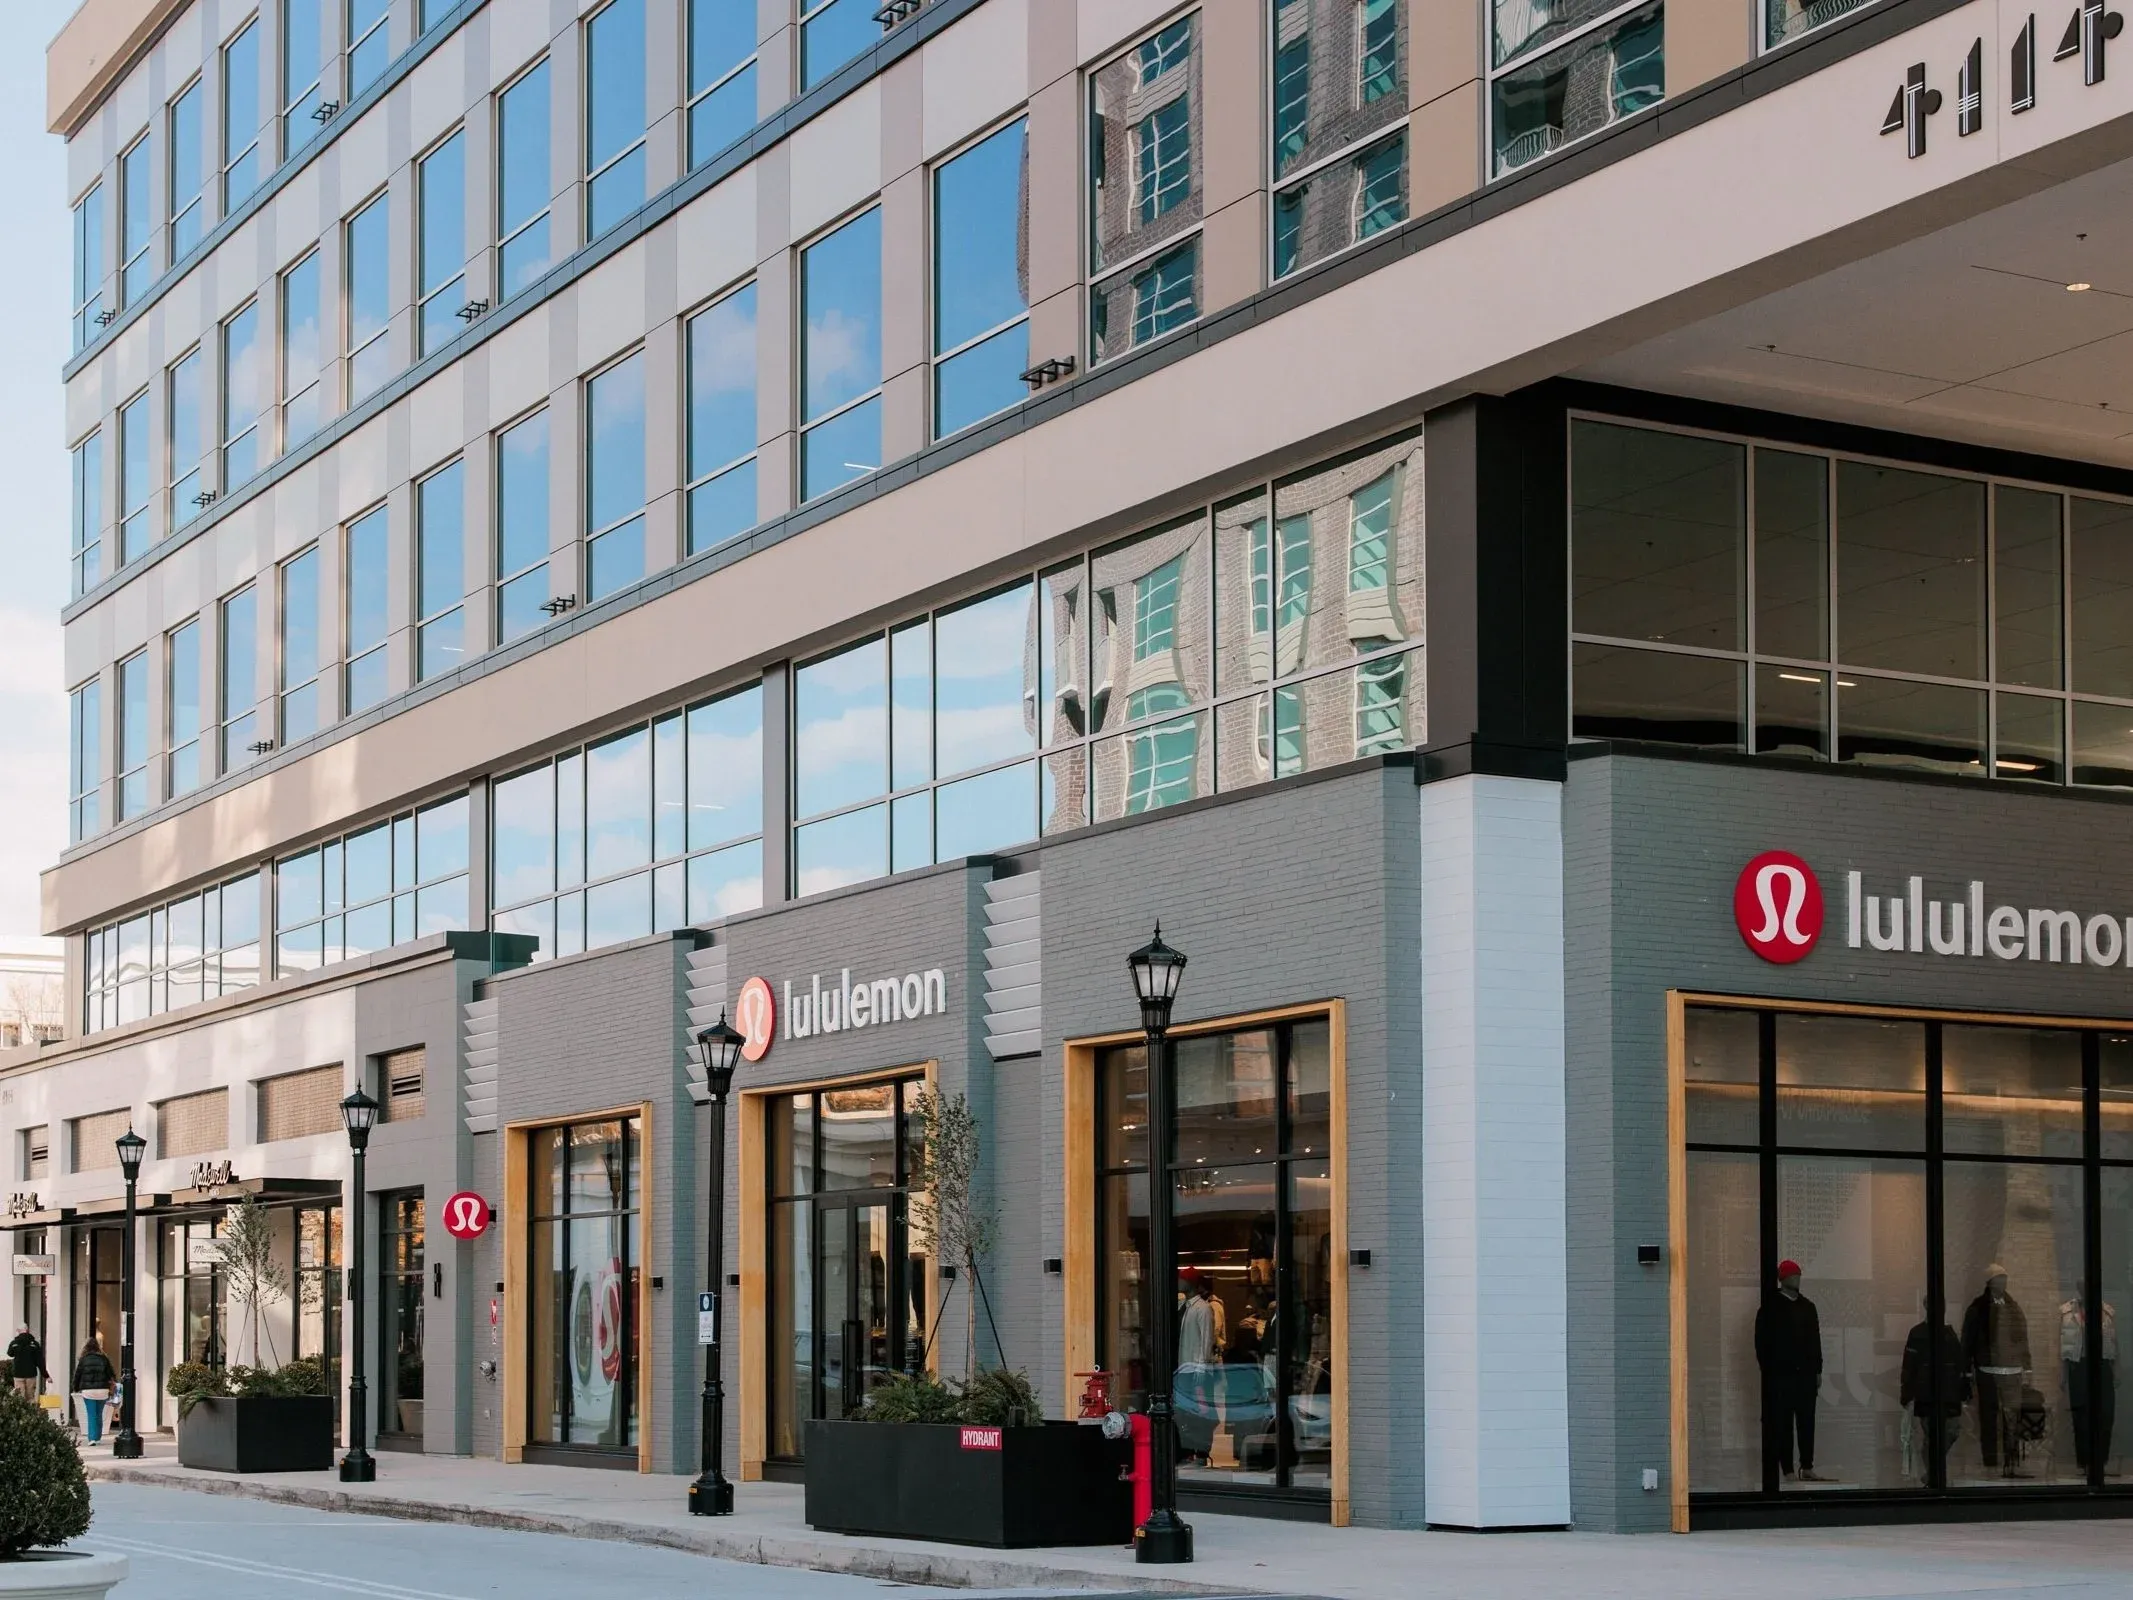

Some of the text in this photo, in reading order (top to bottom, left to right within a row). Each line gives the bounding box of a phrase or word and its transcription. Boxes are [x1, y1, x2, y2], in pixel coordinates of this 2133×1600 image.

[1848, 870, 2133, 967] lululemo
[784, 968, 946, 1040] lululemon
[962, 1430, 999, 1447] HYDRANT
